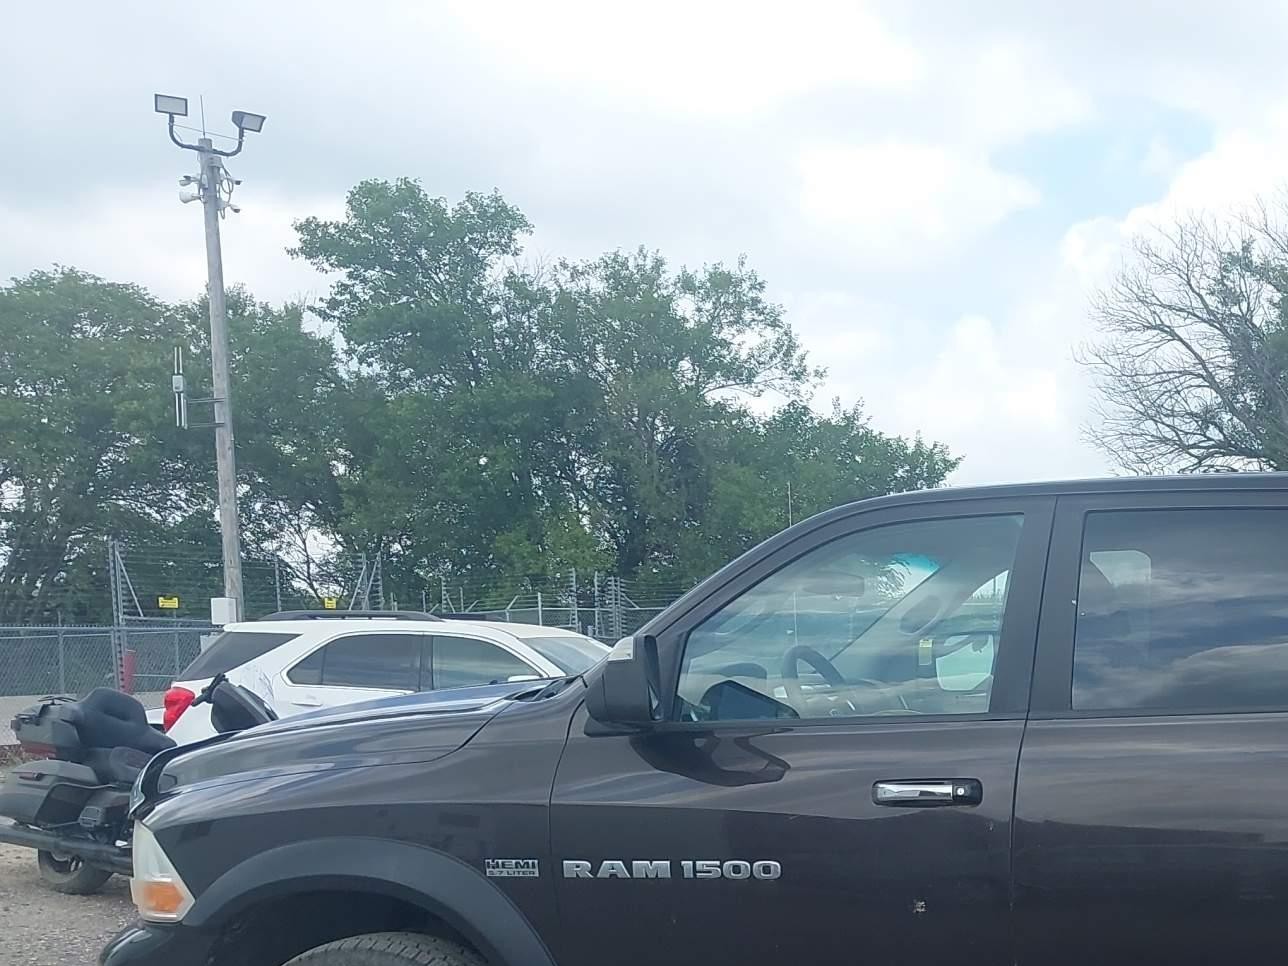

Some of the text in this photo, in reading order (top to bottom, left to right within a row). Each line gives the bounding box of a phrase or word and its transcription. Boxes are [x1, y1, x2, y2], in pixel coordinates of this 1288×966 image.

[486, 859, 537, 870] HEMI
[562, 860, 782, 879] RAM 1500
